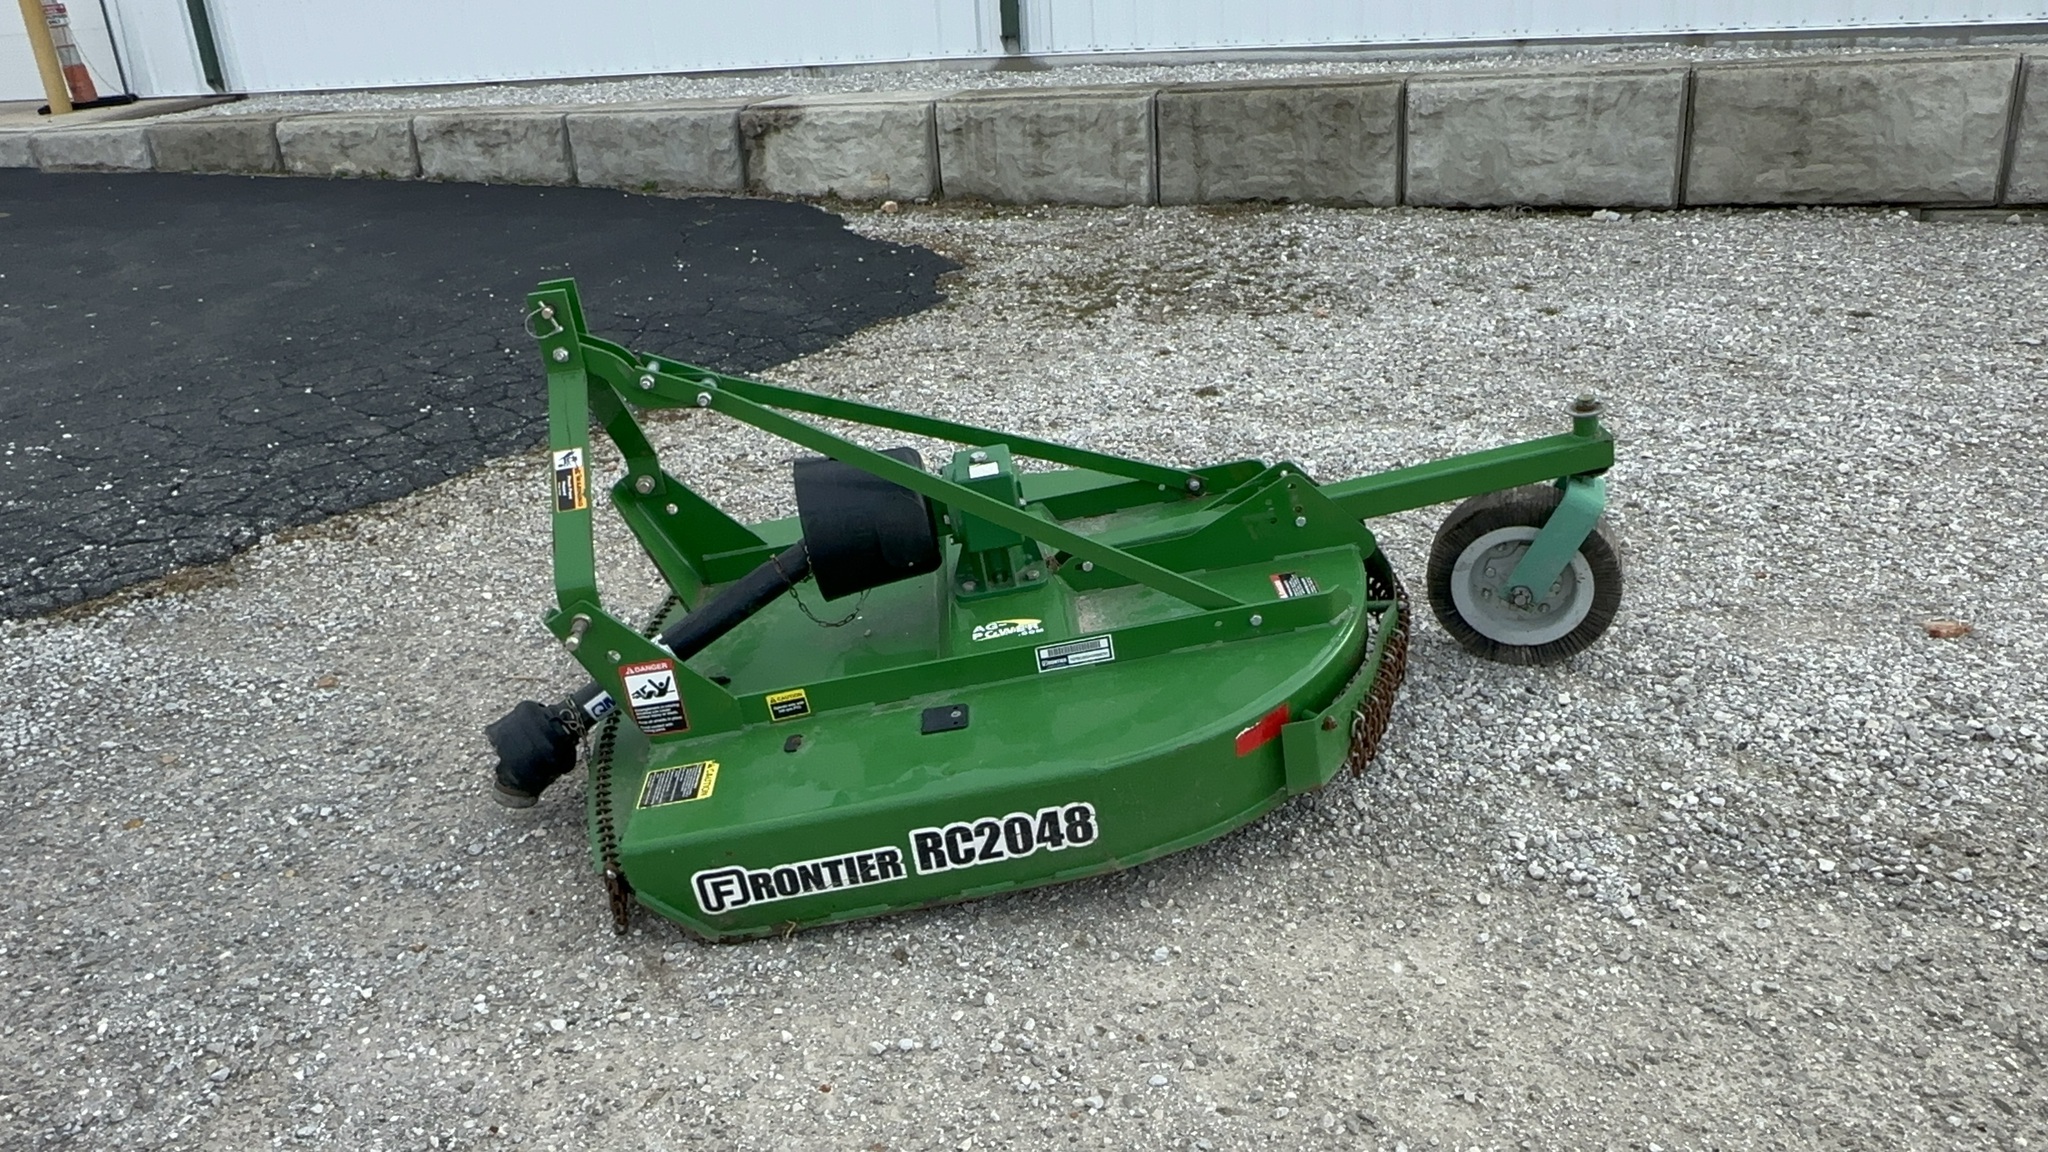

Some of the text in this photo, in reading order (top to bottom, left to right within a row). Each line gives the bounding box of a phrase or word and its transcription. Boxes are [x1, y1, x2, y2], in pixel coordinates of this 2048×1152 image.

[634, 662, 668, 673] DANGER
[777, 692, 803, 701] CAUTION
[700, 768, 715, 797] CAUTION
[696, 803, 1097, 912] FRONTIER RC2048
